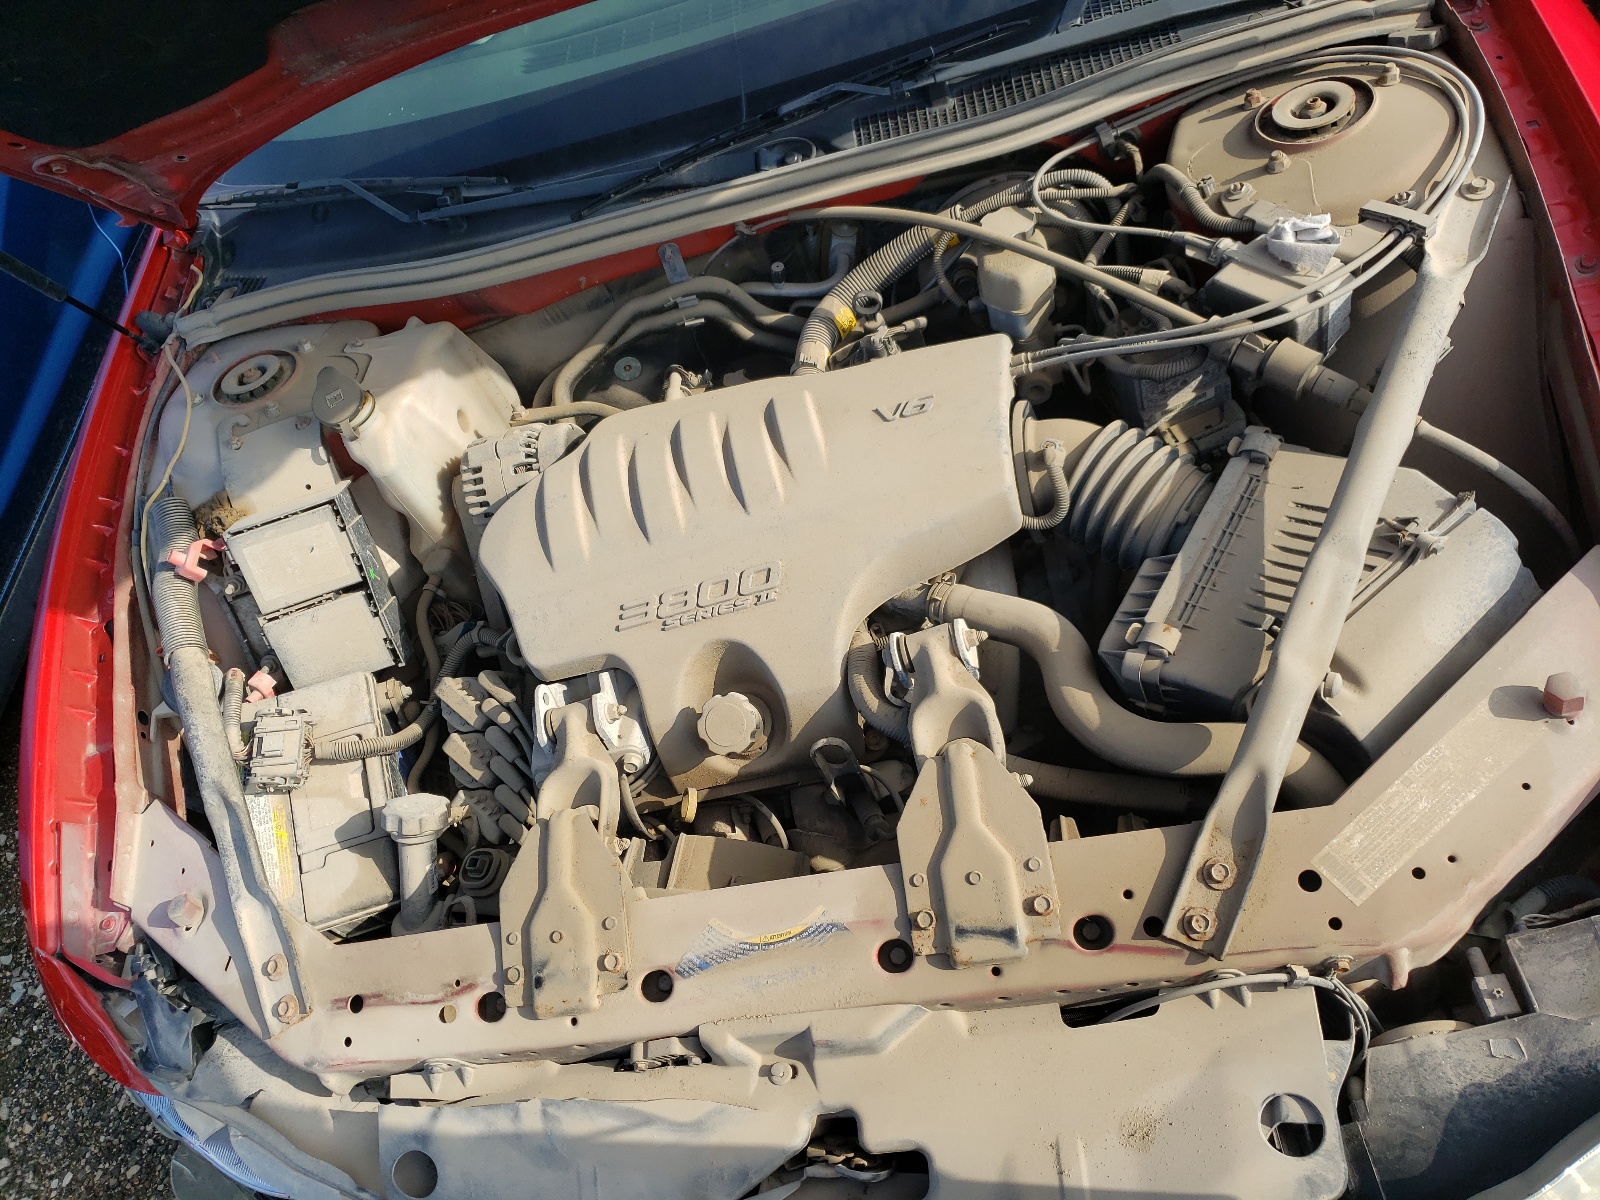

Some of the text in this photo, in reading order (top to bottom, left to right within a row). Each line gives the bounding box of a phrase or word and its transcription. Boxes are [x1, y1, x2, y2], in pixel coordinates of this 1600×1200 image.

[871, 394, 936, 422] V6
[614, 561, 782, 632] 3800
[660, 598, 751, 632] SERIES
